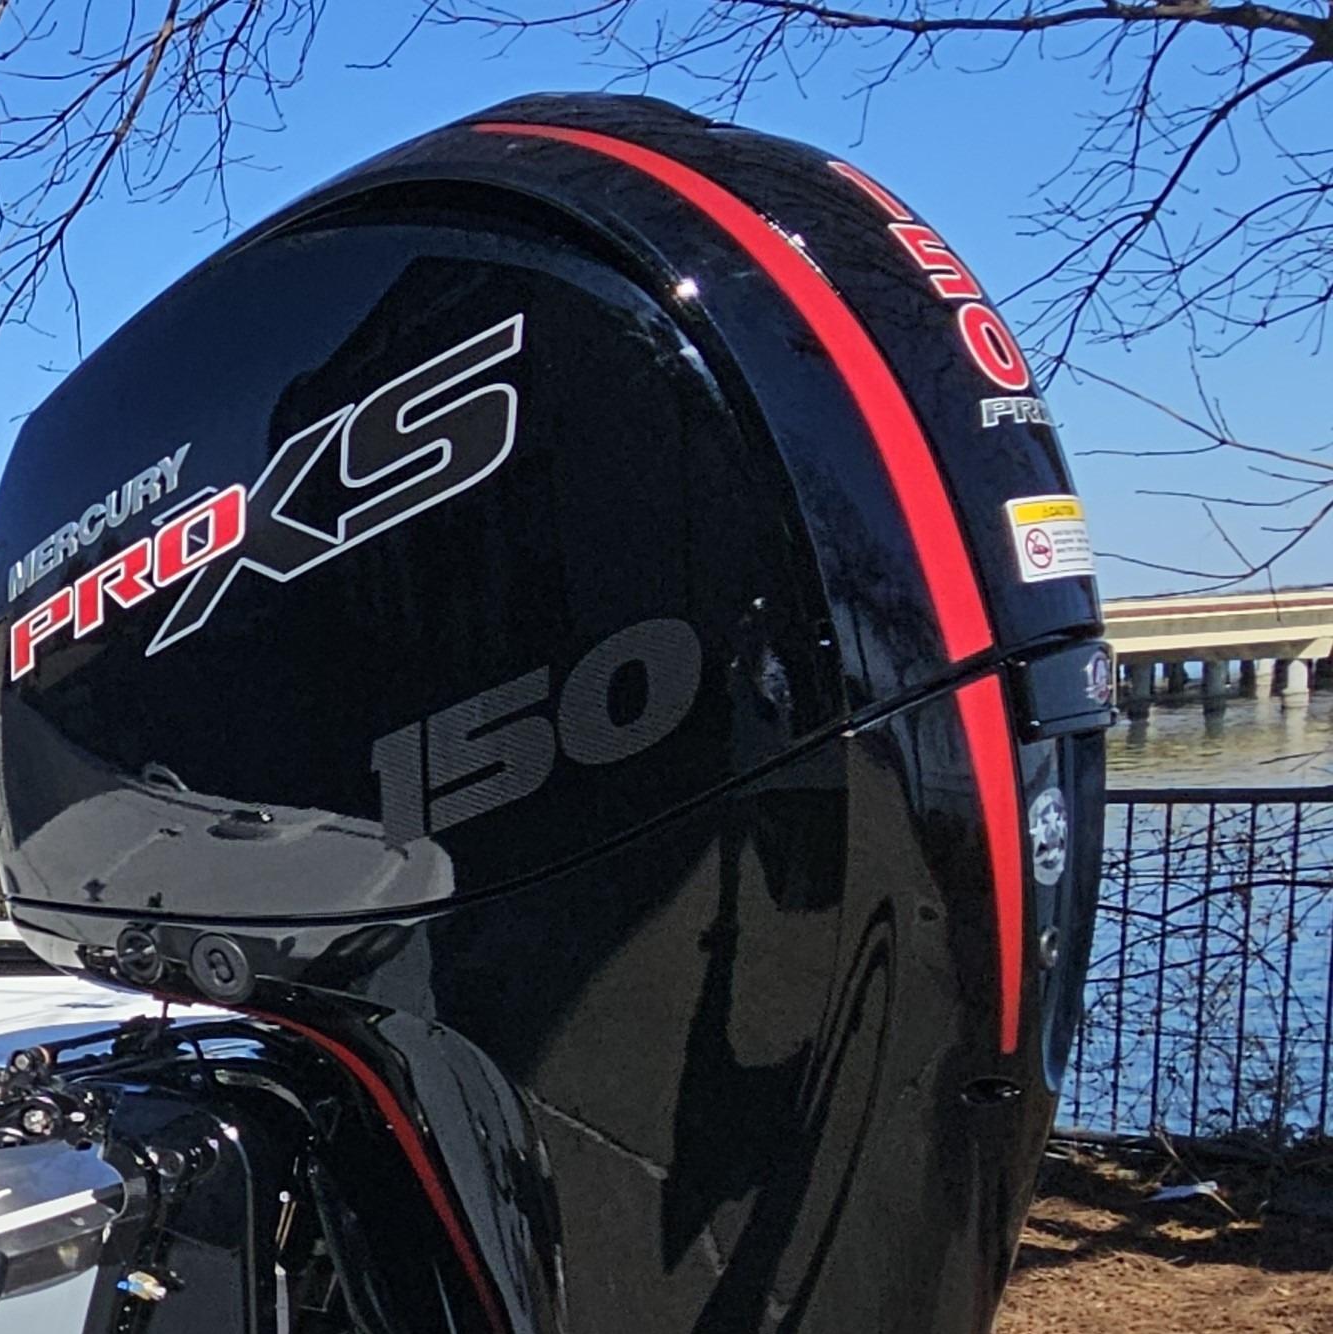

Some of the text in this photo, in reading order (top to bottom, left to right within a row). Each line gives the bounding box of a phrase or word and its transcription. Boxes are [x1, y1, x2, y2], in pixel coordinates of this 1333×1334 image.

[828, 161, 1029, 391] 150
[8, 443, 191, 600] MERCURY
[11, 313, 524, 681] PRO XS
[371, 618, 702, 853] 150
